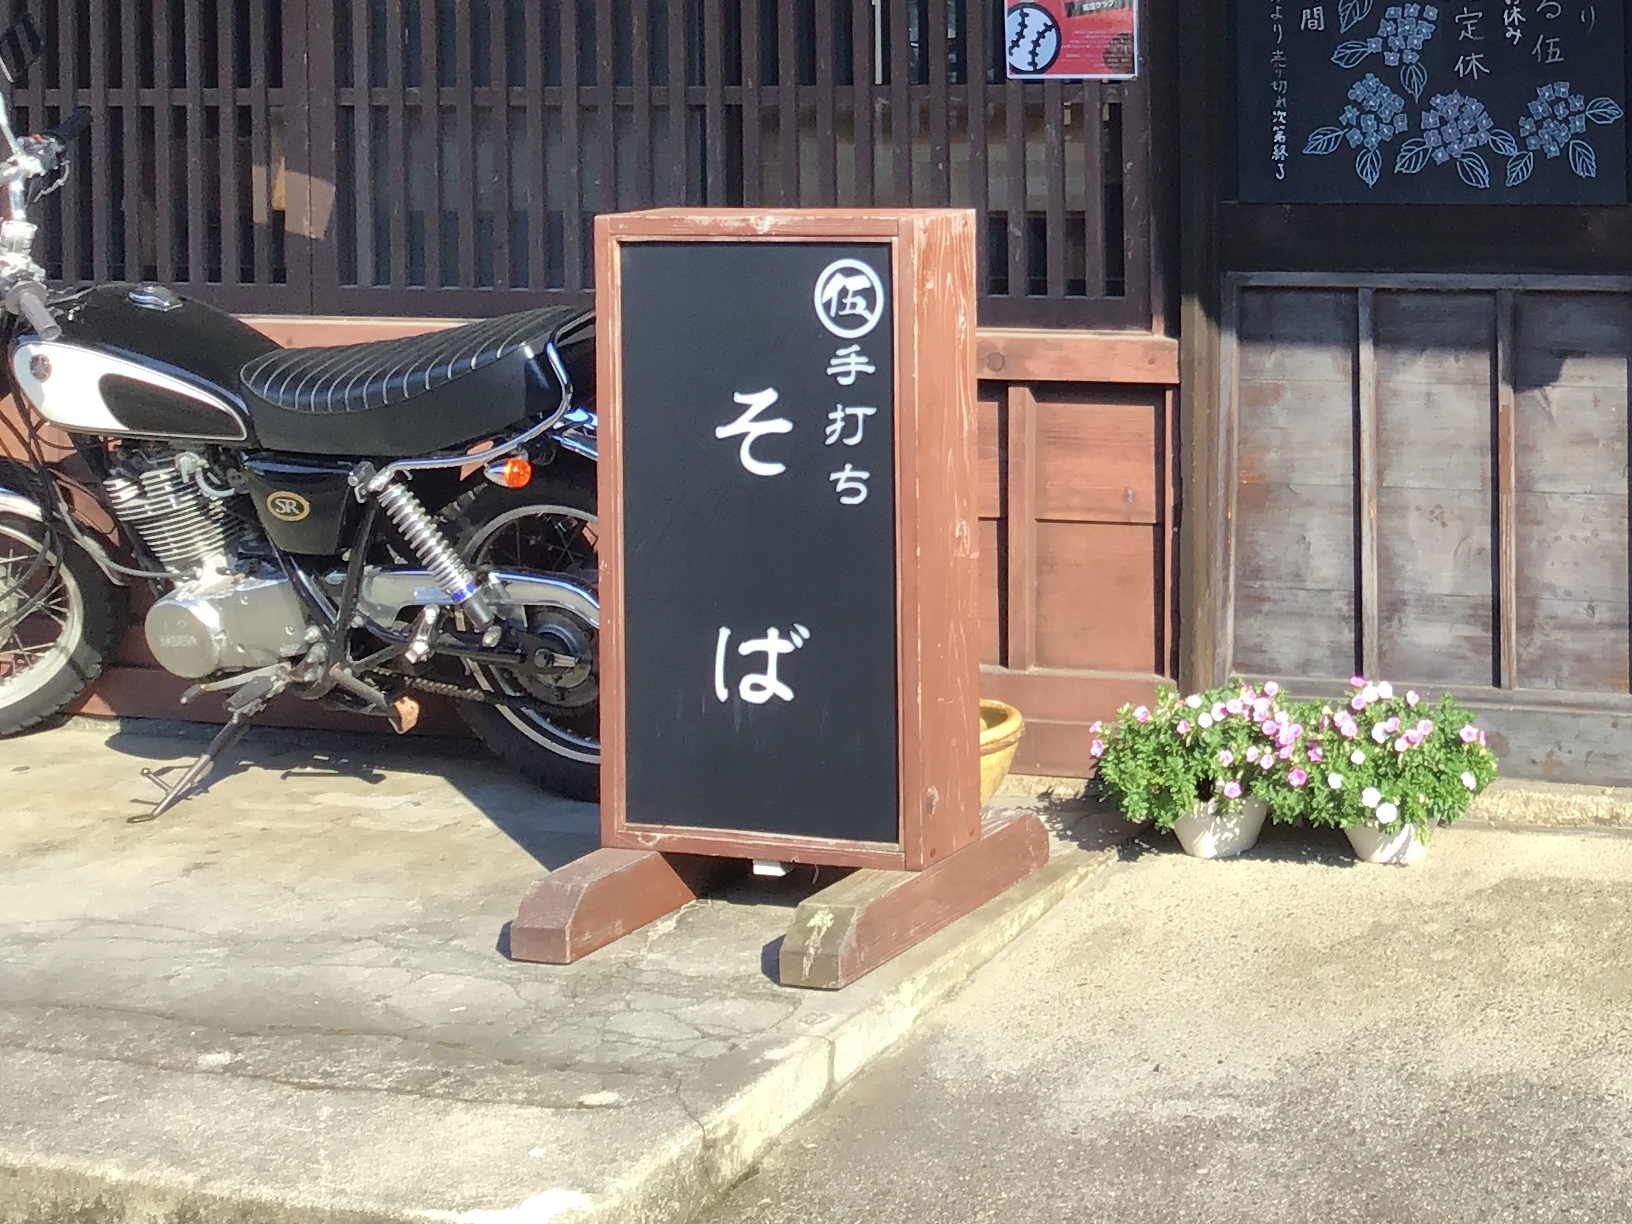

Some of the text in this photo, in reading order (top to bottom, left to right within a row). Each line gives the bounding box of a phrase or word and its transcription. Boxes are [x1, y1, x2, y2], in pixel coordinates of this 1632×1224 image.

[822, 272, 875, 322] 伍
[824, 344, 877, 505] 手打ち
[275, 498, 300, 514] SR
[715, 387, 811, 703] そば
